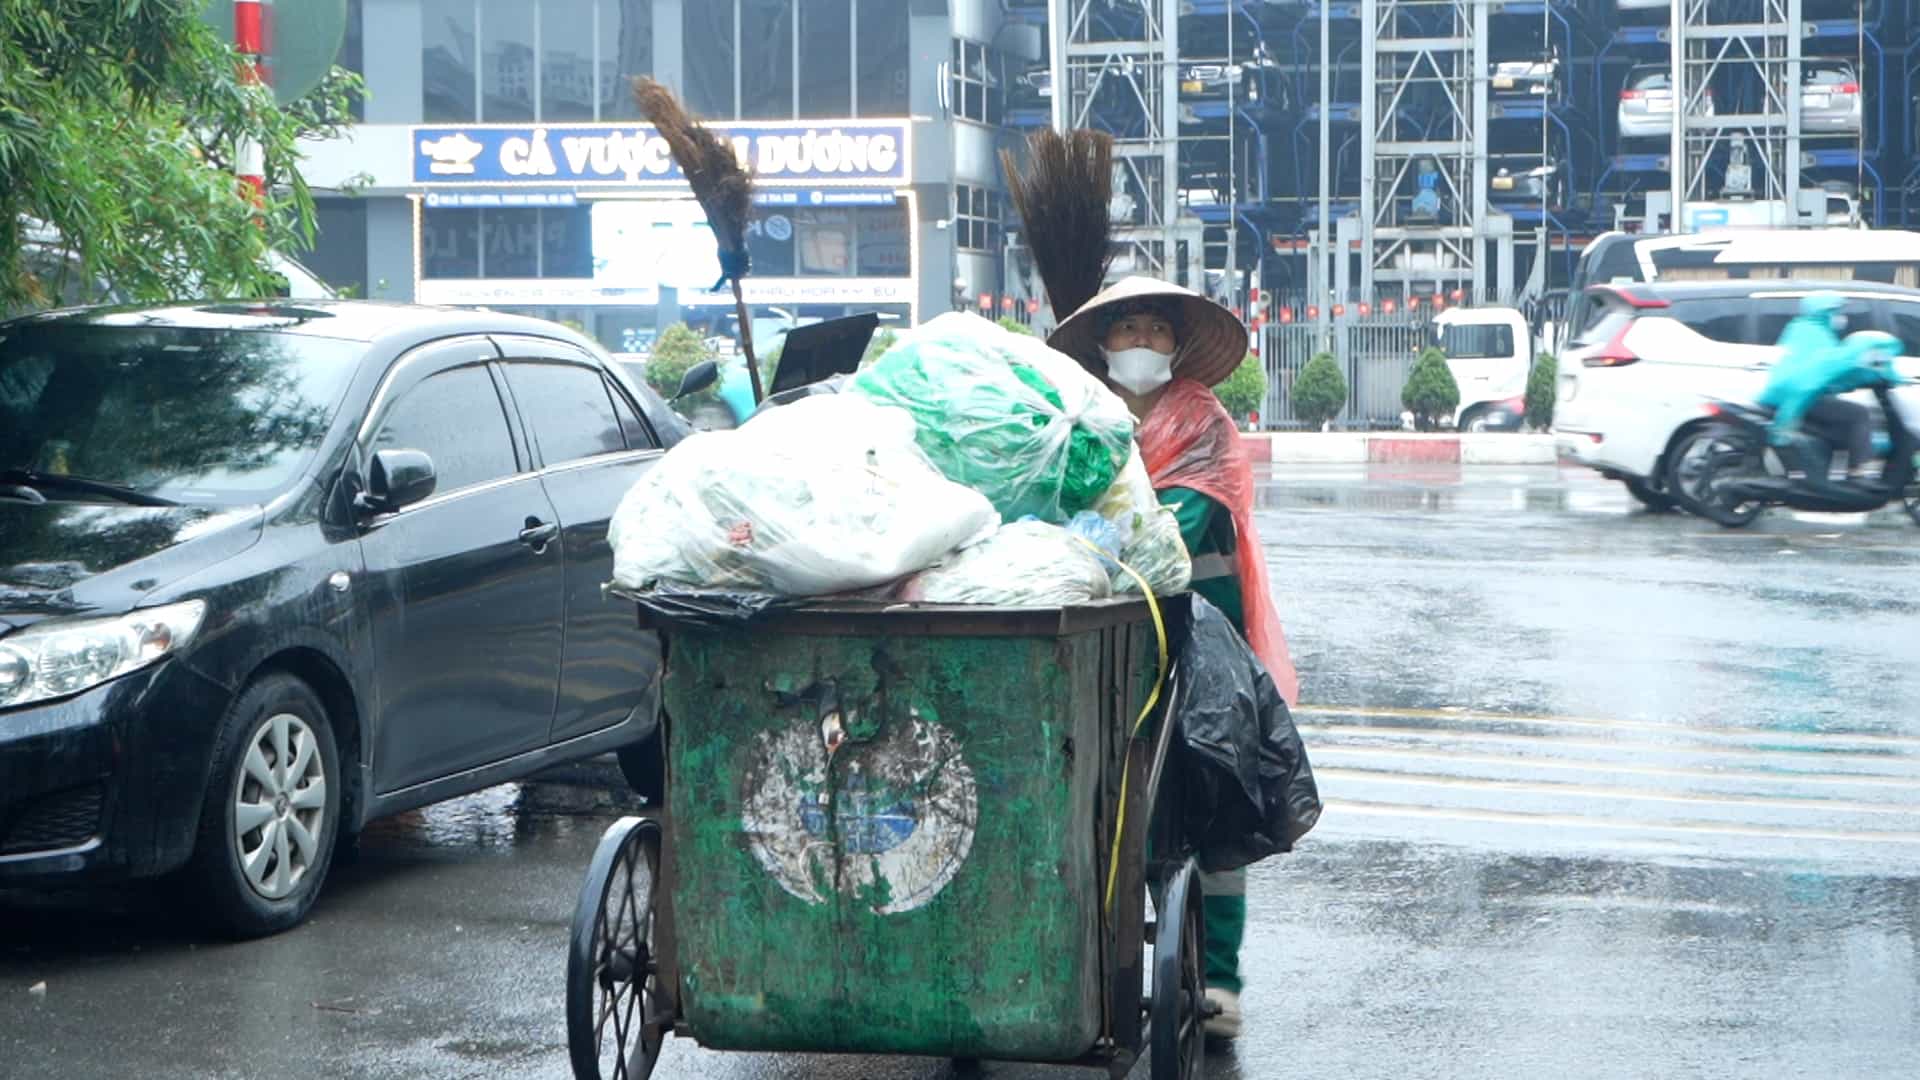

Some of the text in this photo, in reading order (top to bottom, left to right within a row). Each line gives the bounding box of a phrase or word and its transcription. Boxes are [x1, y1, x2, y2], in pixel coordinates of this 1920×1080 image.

[500, 128, 557, 176] CÁ
[561, 130, 672, 182] VƯỢC
[756, 129, 897, 174] DƯƠNG
